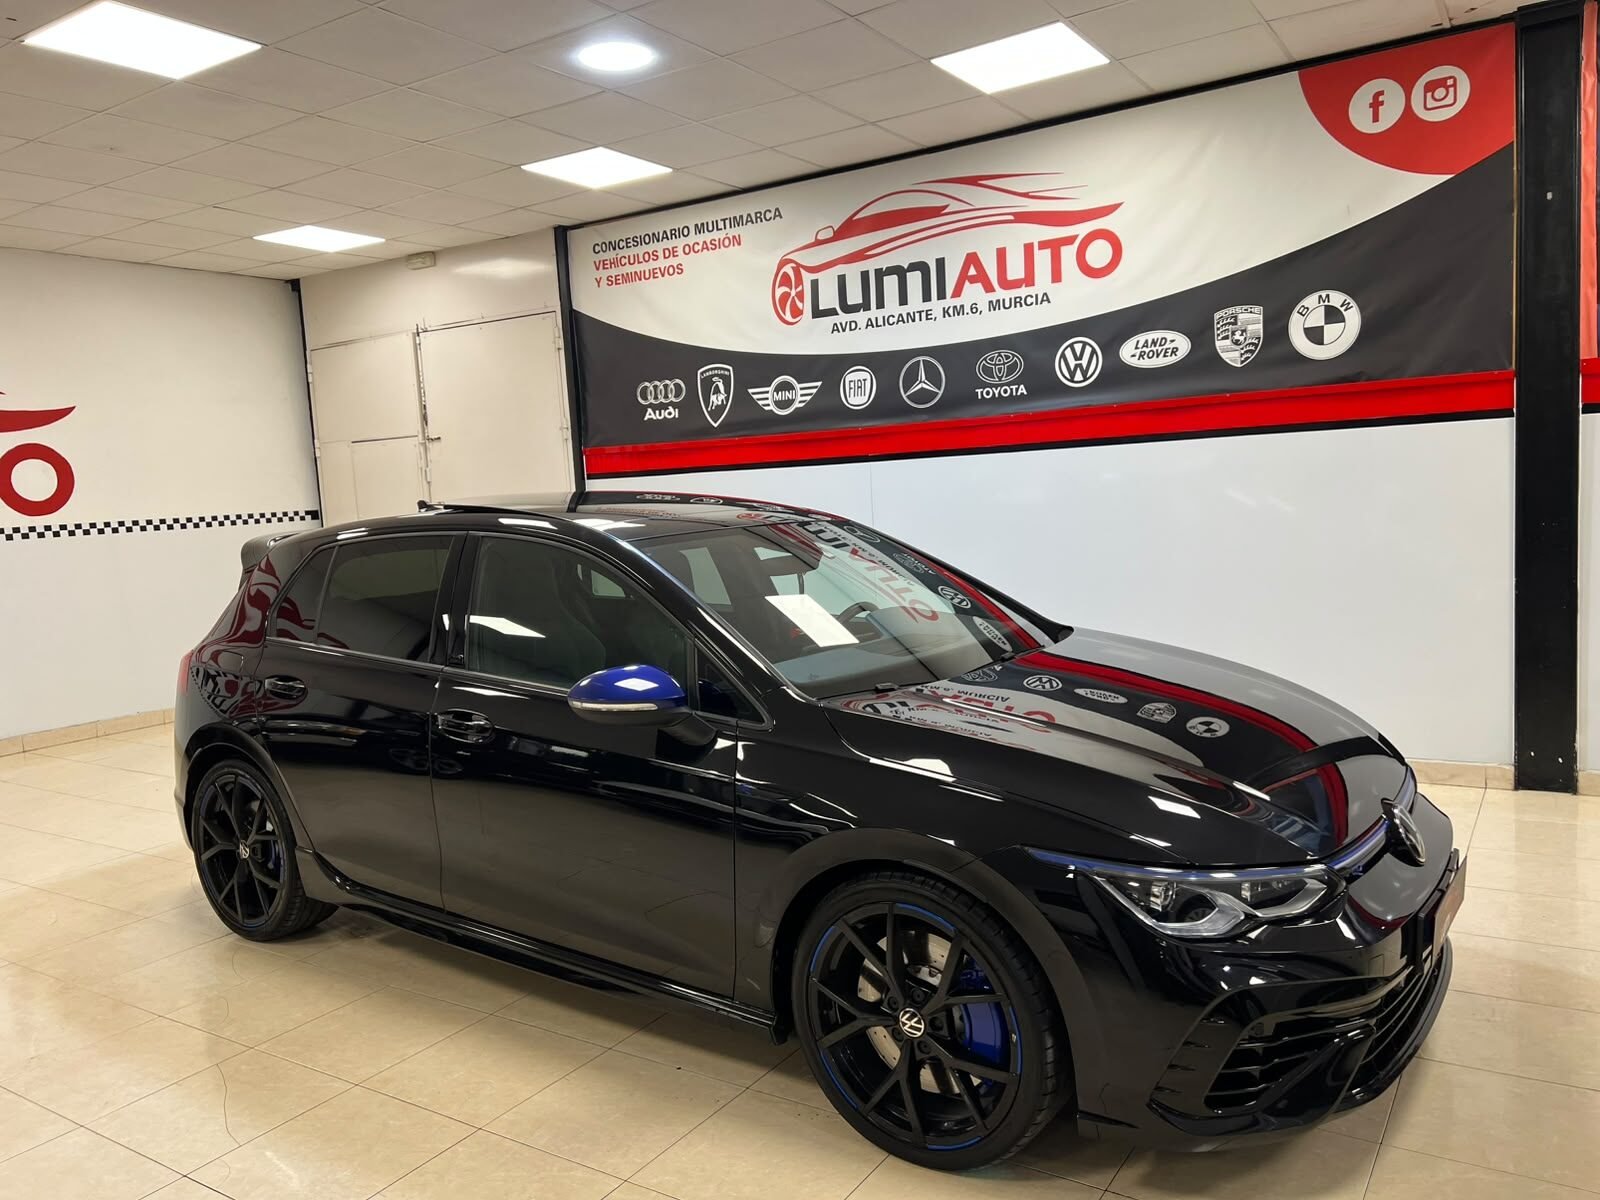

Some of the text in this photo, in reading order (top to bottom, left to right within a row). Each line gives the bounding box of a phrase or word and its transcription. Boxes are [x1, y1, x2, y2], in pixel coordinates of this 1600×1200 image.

[592, 207, 783, 255] CONCESIONARIO MULTIMARCA
[593, 233, 742, 272] VEHÍCULOS DE OCASIÓN
[594, 262, 684, 288] Y SEMINUEVOS
[830, 292, 1051, 335] AVD. ALICANTE, KM.6, MURCIA
[1216, 307, 1261, 320] PORSCHE
[773, 389, 796, 402] MINI
[848, 377, 868, 399] FIAT
[975, 384, 1028, 400] TOYOTA
[643, 405, 679, 421] Audi
